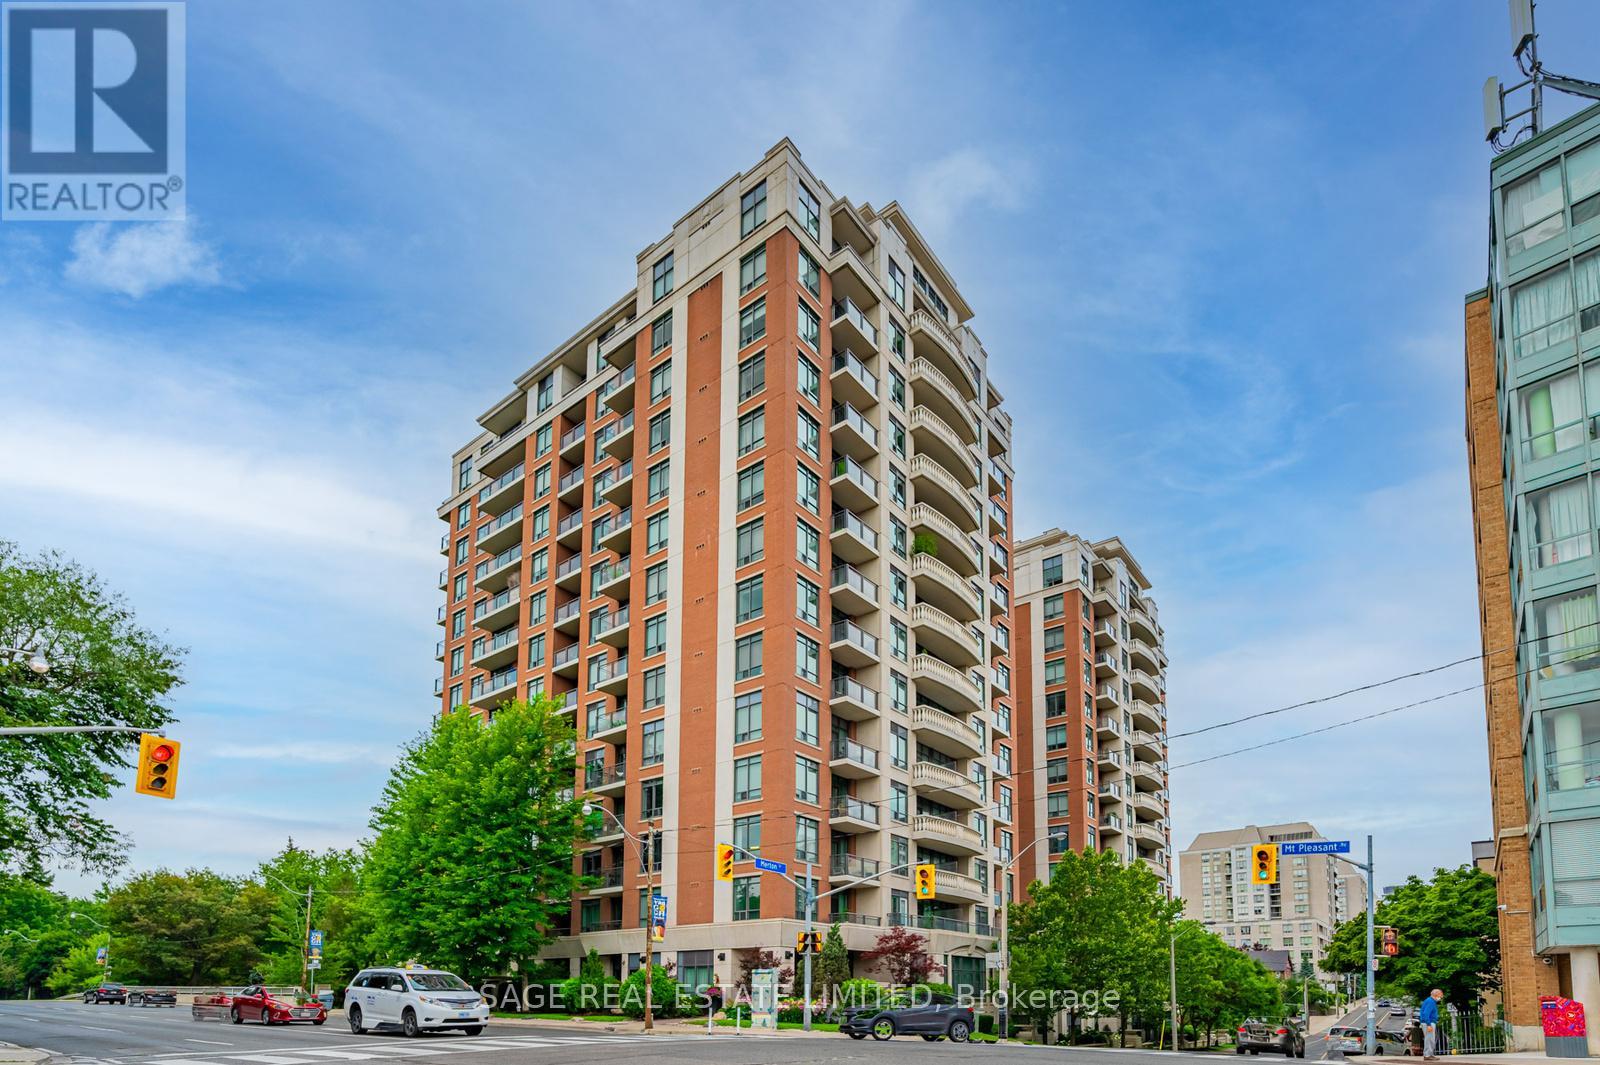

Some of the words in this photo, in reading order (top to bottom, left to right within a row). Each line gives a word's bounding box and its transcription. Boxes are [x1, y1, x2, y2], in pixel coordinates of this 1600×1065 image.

[1285, 844, 1295, 853] Mt
[1299, 843, 1337, 852] Pleasant
[760, 860, 778, 870] Merton
